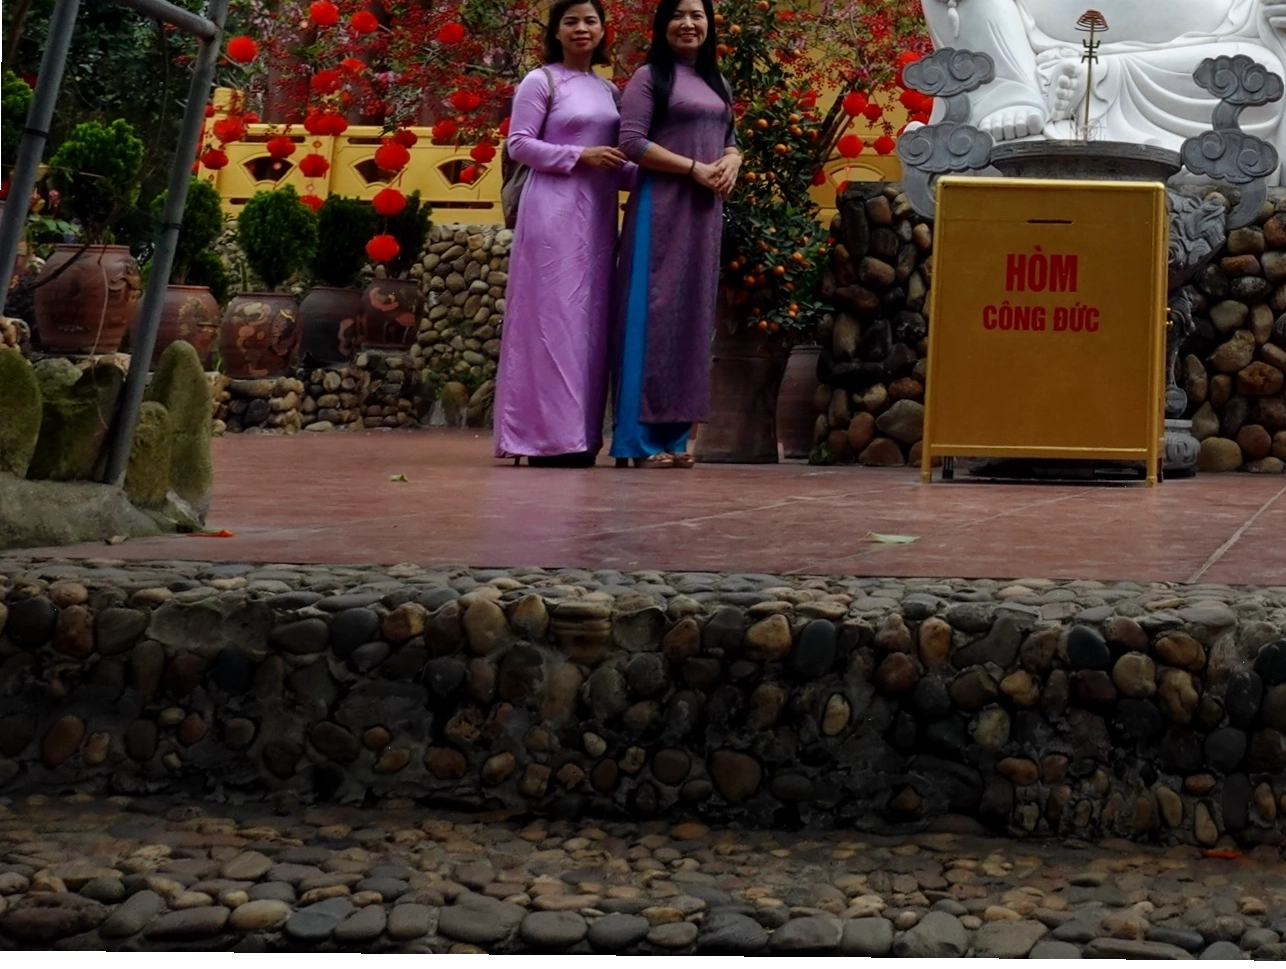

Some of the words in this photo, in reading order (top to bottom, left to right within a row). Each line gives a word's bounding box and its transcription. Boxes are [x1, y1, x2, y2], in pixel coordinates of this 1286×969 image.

[1005, 244, 1079, 293] HÒM
[982, 299, 1047, 332] CÔNG
[1052, 301, 1101, 333] ĐỨC
